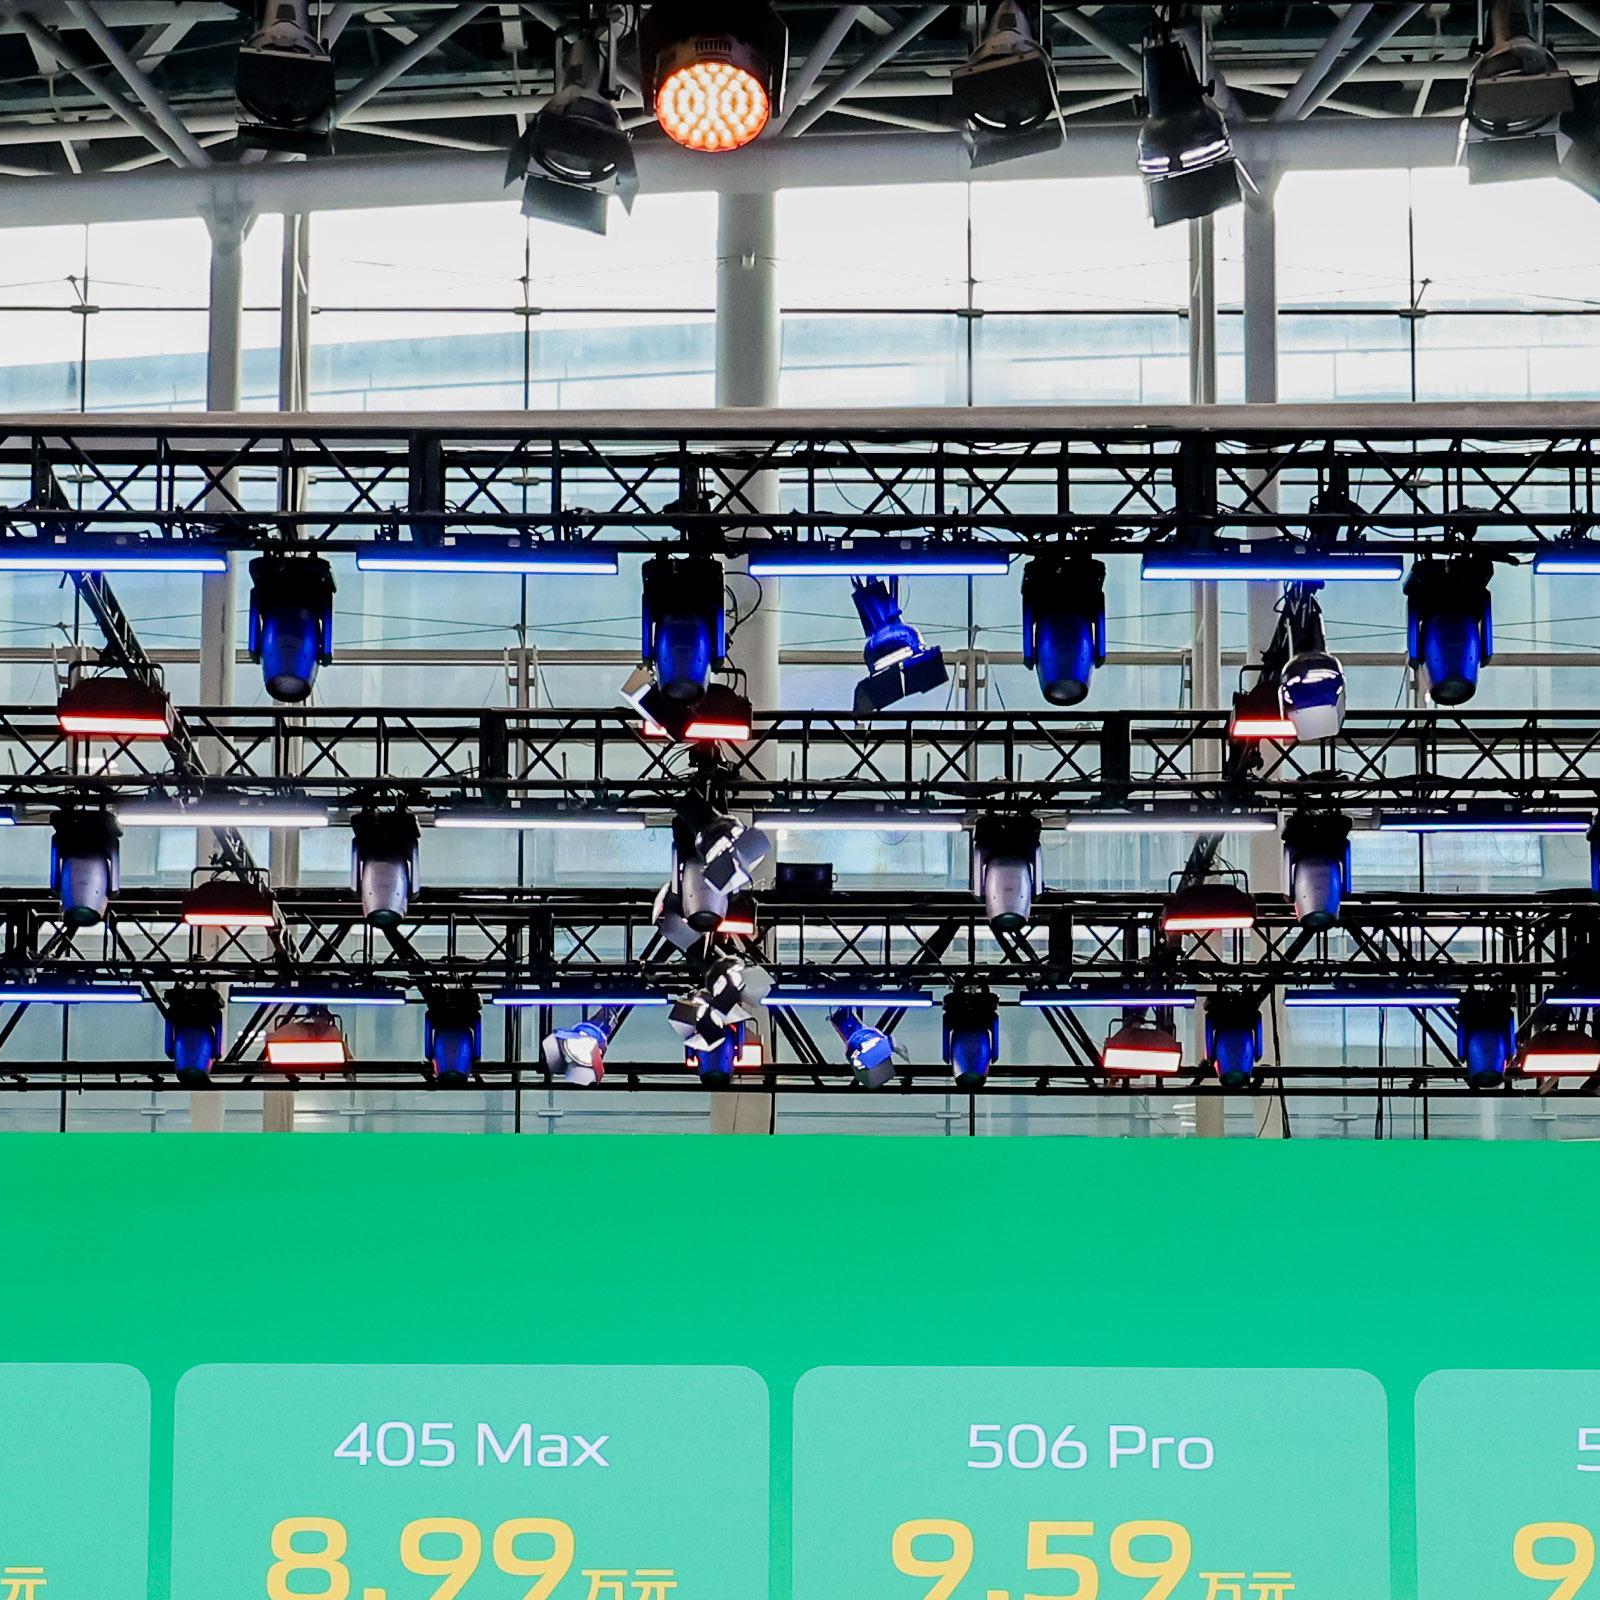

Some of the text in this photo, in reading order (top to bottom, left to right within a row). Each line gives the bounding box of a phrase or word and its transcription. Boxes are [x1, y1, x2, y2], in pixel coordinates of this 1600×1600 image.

[333, 1421, 610, 1467] 405 Max
[967, 1423, 1214, 1470] 506 Pro
